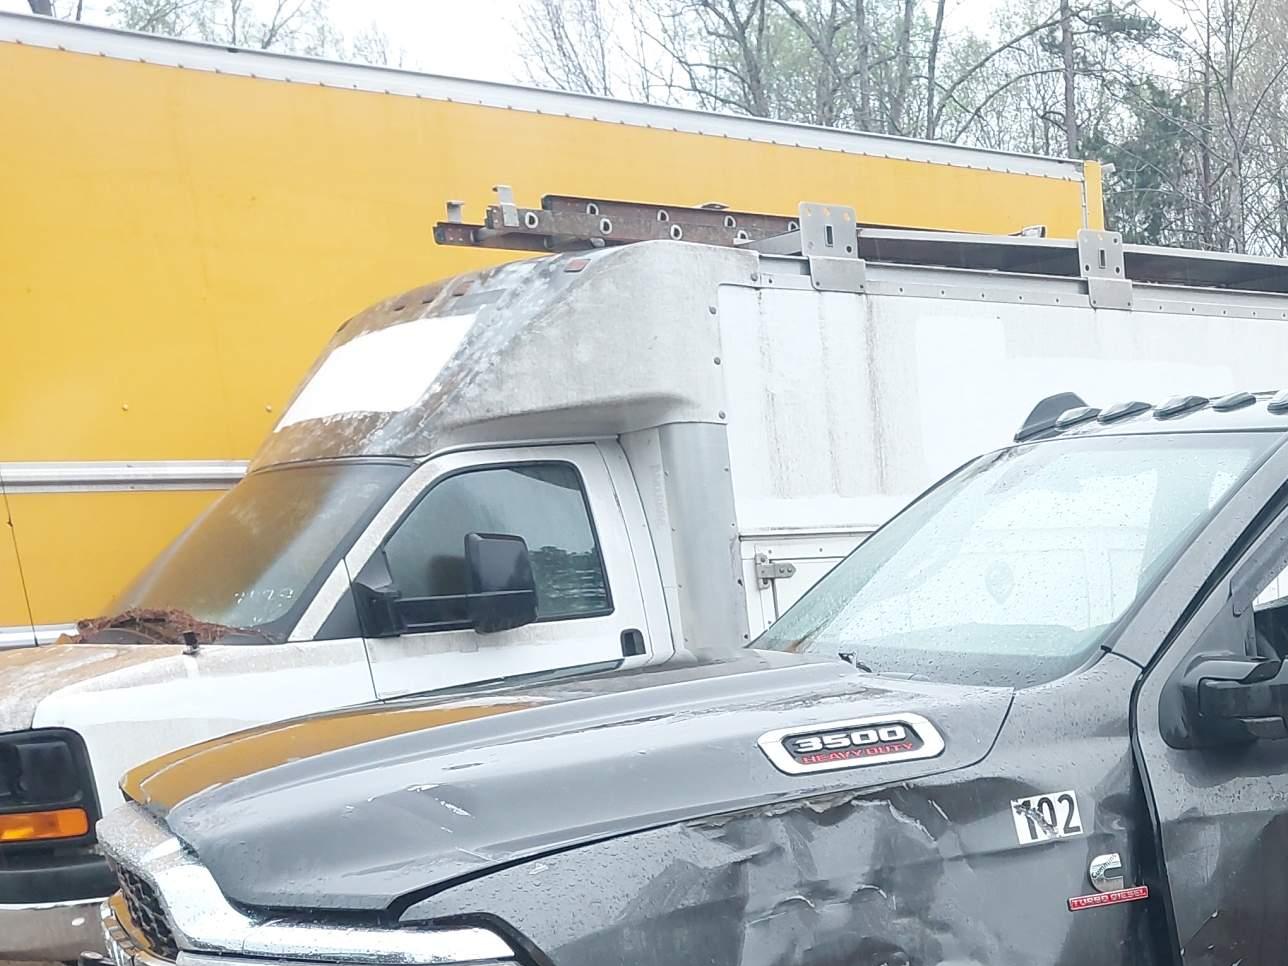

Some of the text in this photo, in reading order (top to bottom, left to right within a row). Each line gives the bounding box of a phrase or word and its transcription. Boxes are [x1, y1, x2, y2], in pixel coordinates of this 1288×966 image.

[795, 726, 907, 753] 3500
[802, 743, 914, 765] HEAVY DUTY
[1014, 793, 1081, 840] 102
[1071, 889, 1147, 907] TURBO DIESEL
